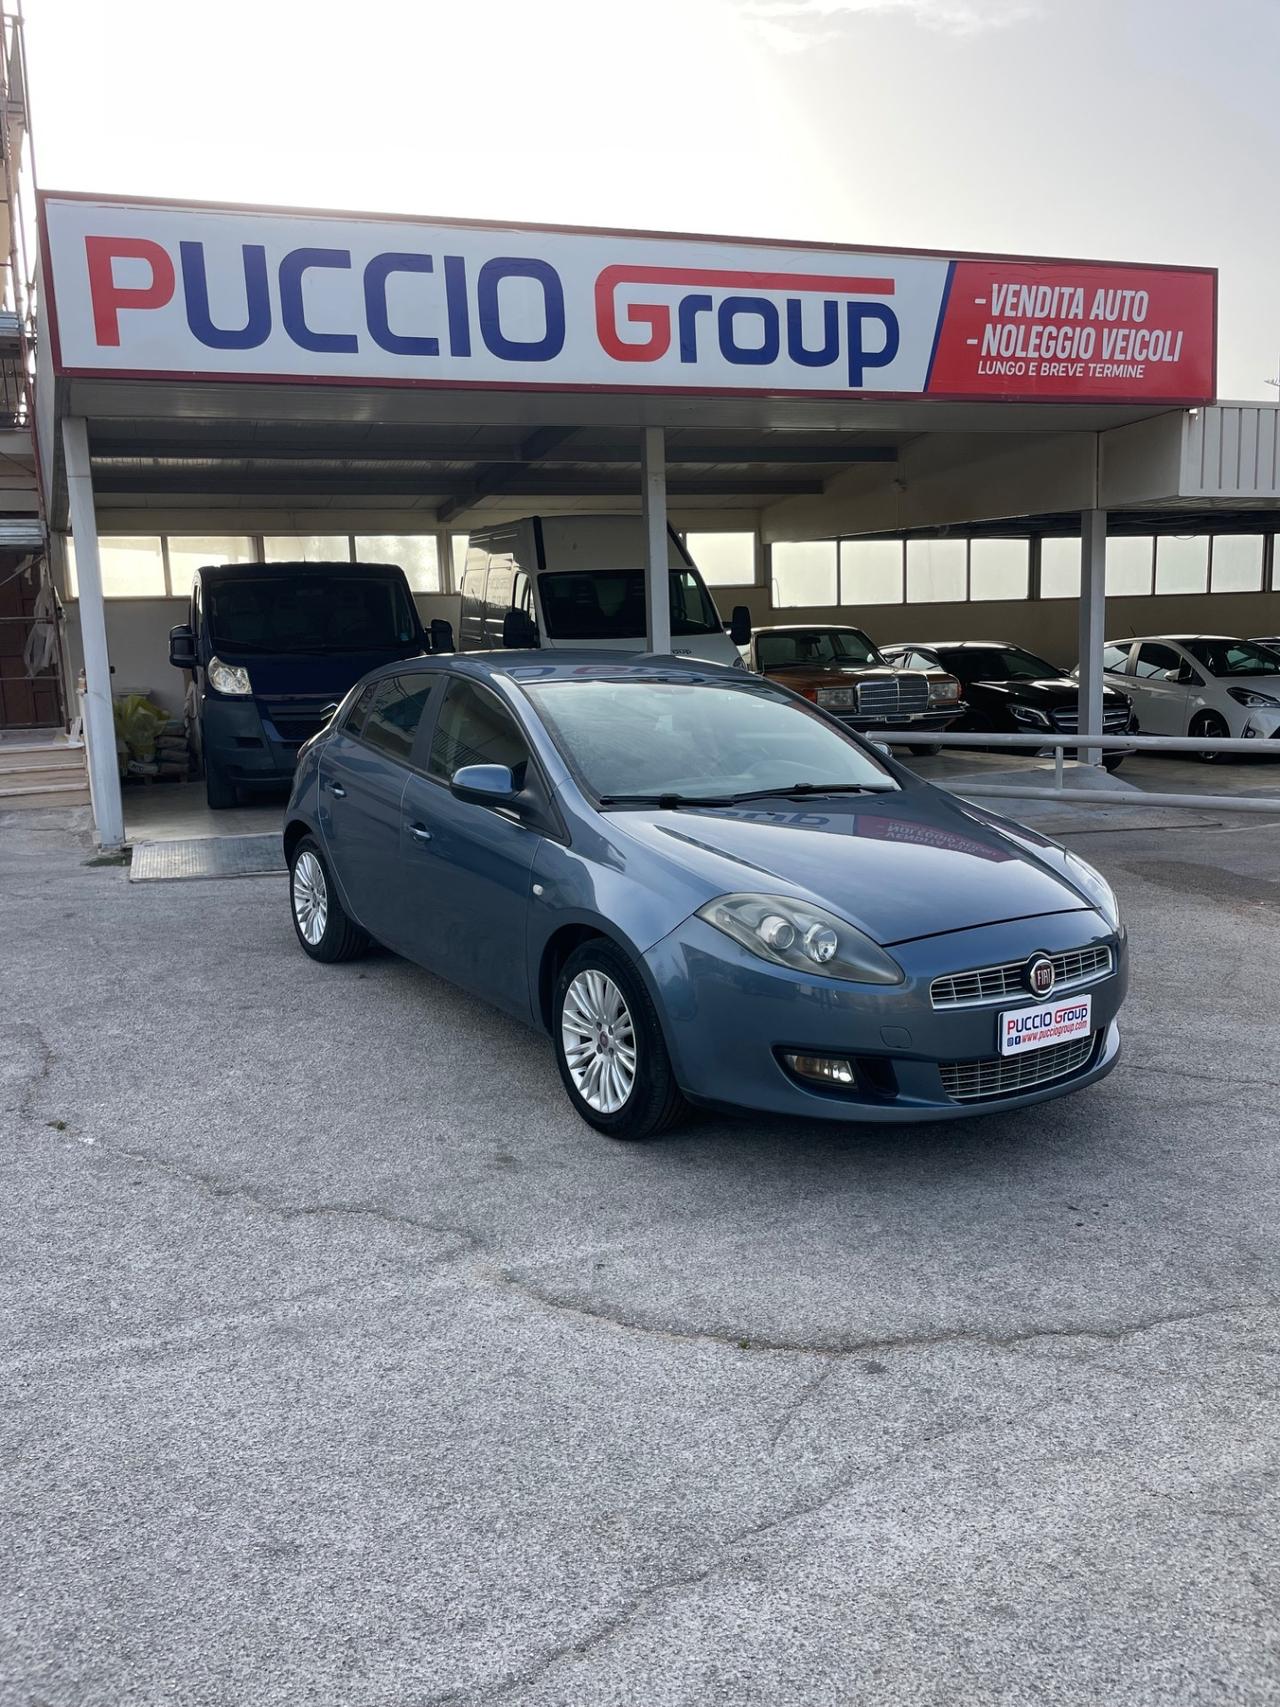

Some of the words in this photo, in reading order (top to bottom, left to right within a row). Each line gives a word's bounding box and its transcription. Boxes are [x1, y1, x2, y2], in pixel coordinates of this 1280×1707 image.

[84, 235, 566, 362] PUCCIO
[594, 264, 900, 388] Group
[991, 283, 1085, 320] VENDITA
[1089, 288, 1150, 323] AUTO
[981, 323, 1097, 360] NOLEGGIO
[1102, 327, 1184, 362] VEICOLI
[977, 360, 1026, 376] LUNGO
[1028, 362, 1039, 376] E
[1040, 362, 1086, 377] BREVE
[1088, 363, 1146, 379] TERMINE
[1037, 968, 1051, 986] FIAT
[1007, 1011, 1052, 1035] PUCCIO
[1054, 1004, 1088, 1024] Group
[1021, 1020, 1088, 1044] www.pucciogroup.com
